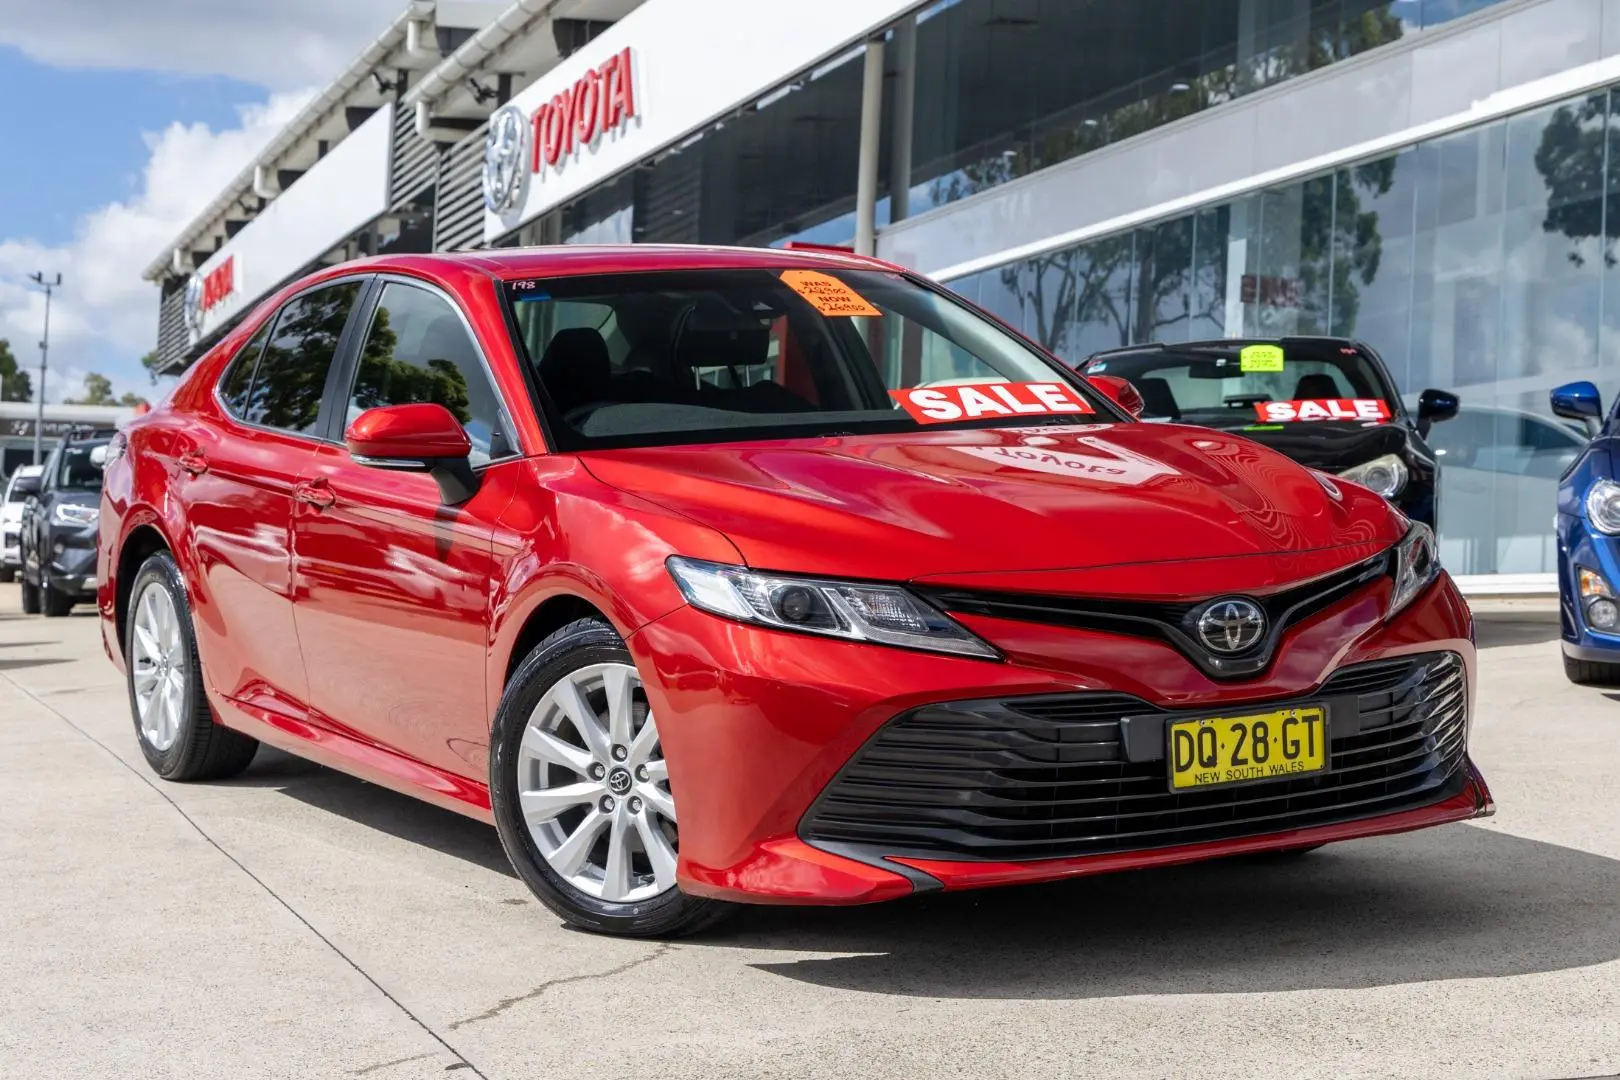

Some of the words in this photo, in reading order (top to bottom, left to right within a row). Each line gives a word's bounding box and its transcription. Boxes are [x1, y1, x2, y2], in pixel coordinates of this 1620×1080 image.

[530, 46, 635, 174] TOYOTA
[908, 384, 1082, 420] SALE
[1265, 400, 1384, 420] SALE
[1194, 770, 1221, 784] NEW
[1226, 765, 1265, 780] SOUTH
[1269, 761, 1305, 774] WALES
